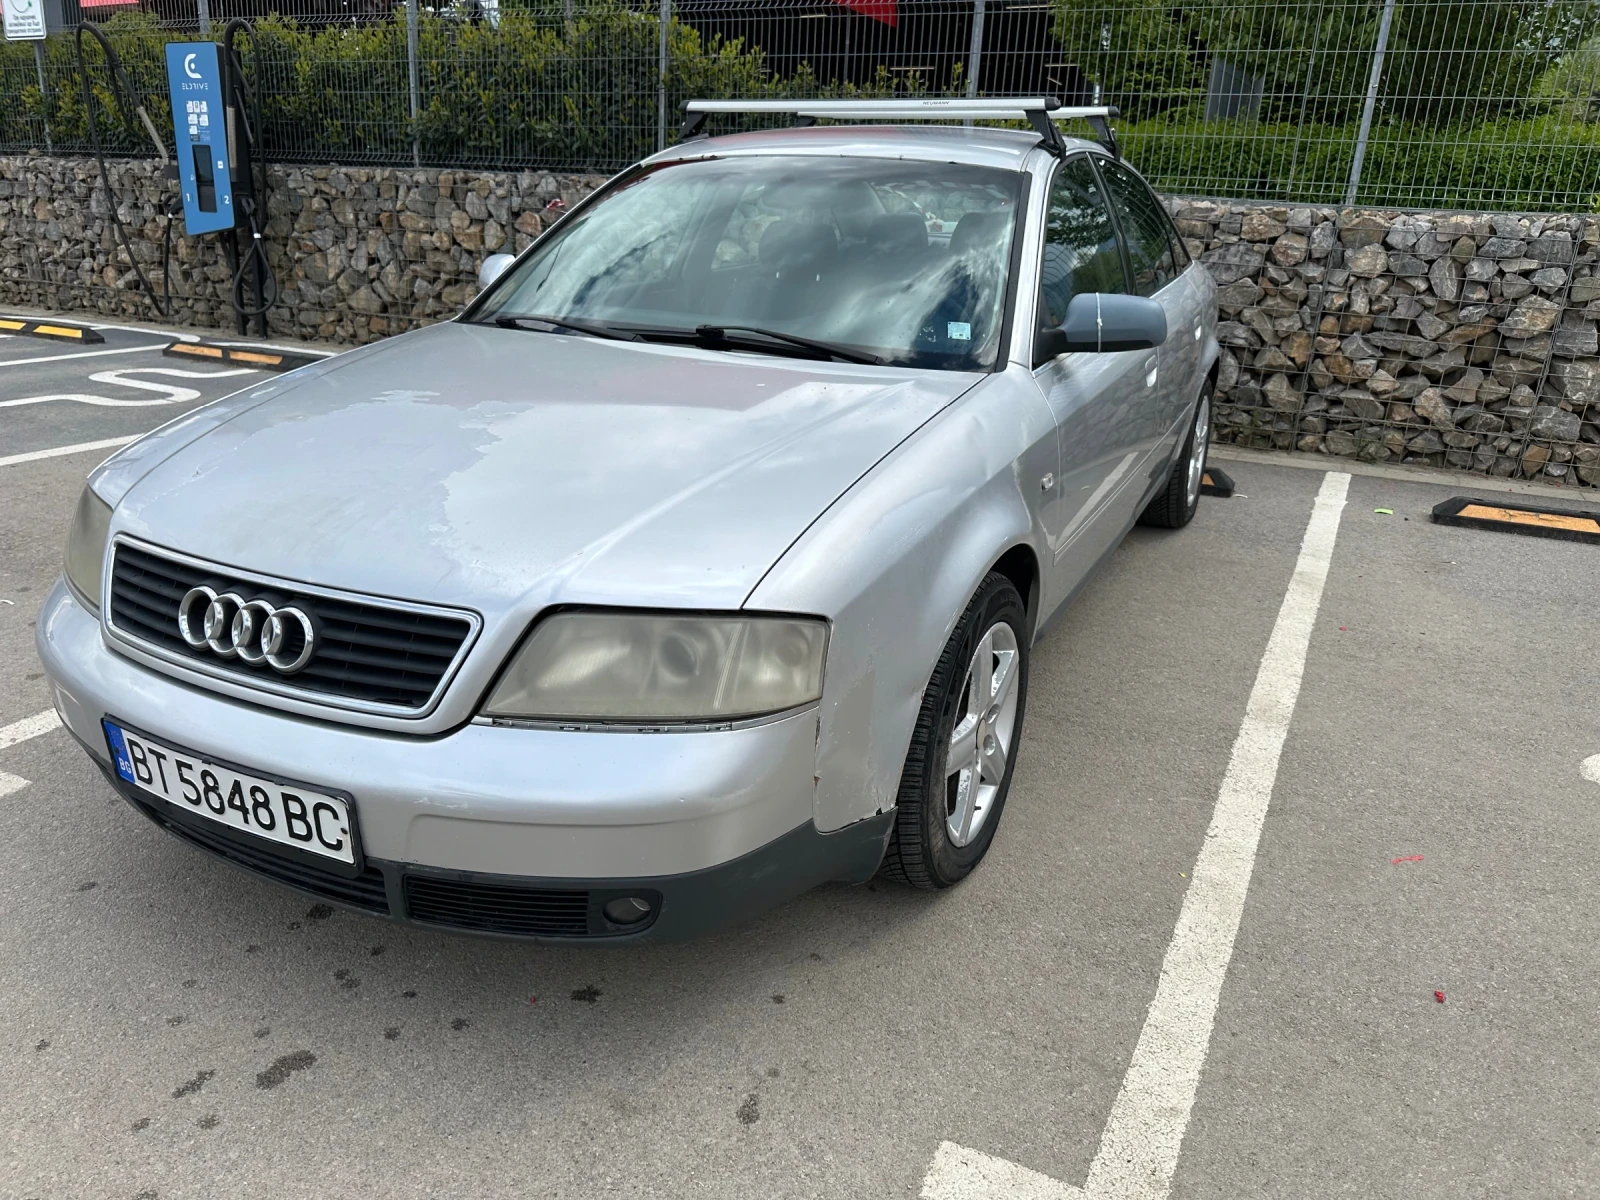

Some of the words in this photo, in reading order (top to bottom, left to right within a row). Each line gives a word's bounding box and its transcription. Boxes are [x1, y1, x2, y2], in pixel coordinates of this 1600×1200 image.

[181, 82, 208, 90] ELDRIVE
[186, 193, 190, 202] 1
[224, 195, 230, 204] 2
[118, 757, 131, 774] BG
[127, 737, 169, 794] BT
[175, 758, 276, 831] 5848
[280, 791, 343, 851] BC
